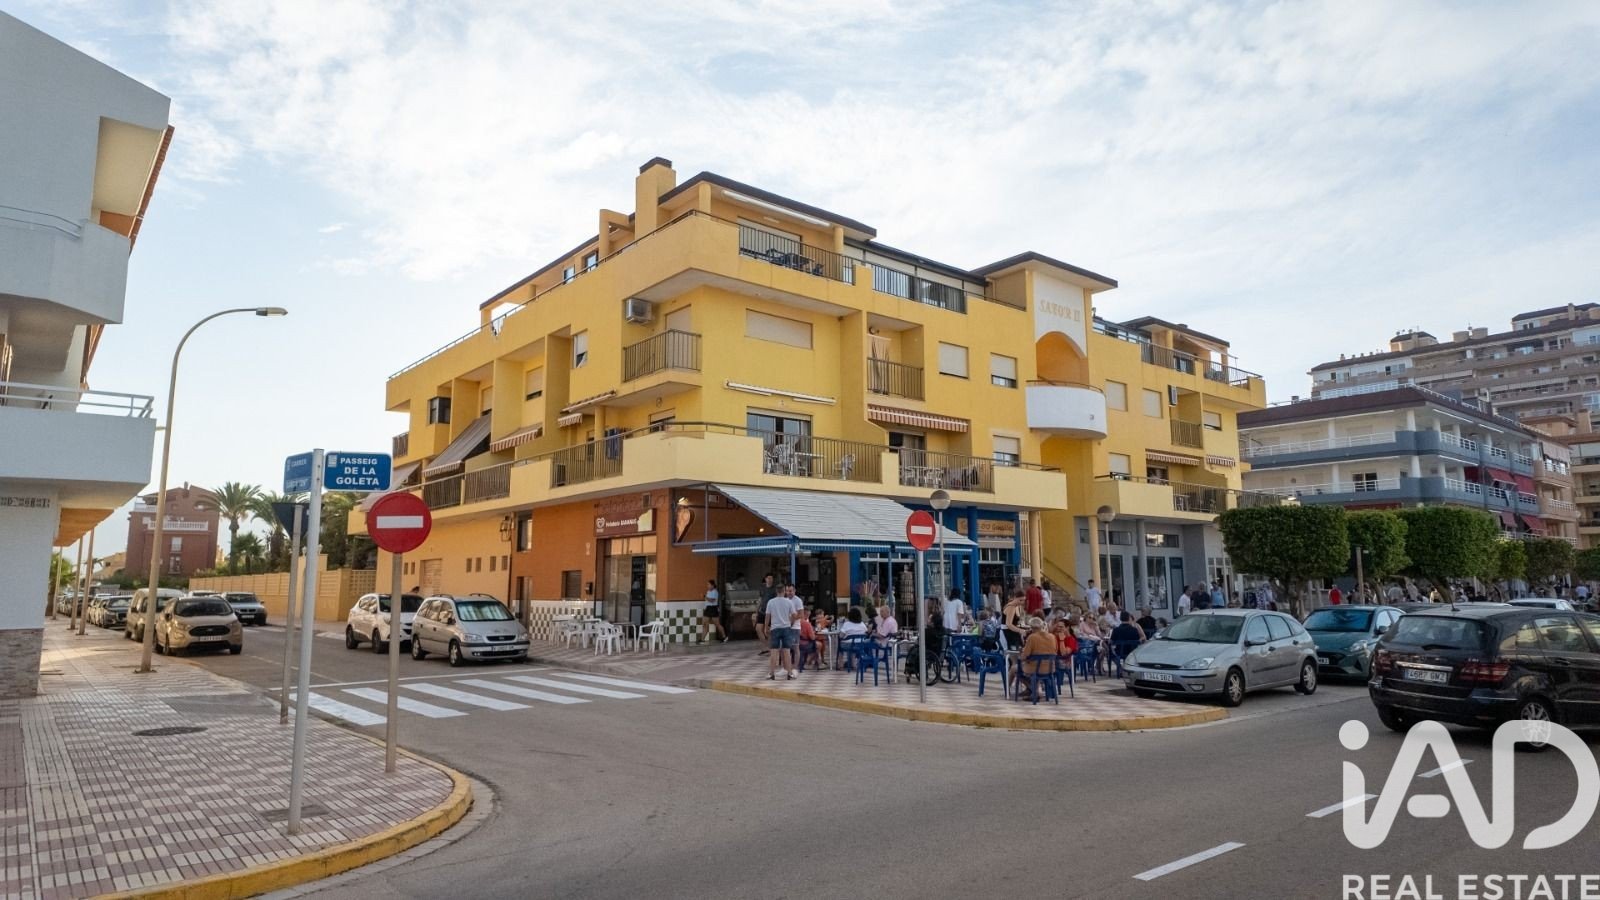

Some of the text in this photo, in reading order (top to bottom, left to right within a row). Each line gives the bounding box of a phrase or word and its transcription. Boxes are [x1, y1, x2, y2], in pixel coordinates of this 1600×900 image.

[340, 457, 378, 465] PASSEIG
[344, 466, 376, 475] DE LA
[336, 476, 380, 486] GOLETA
